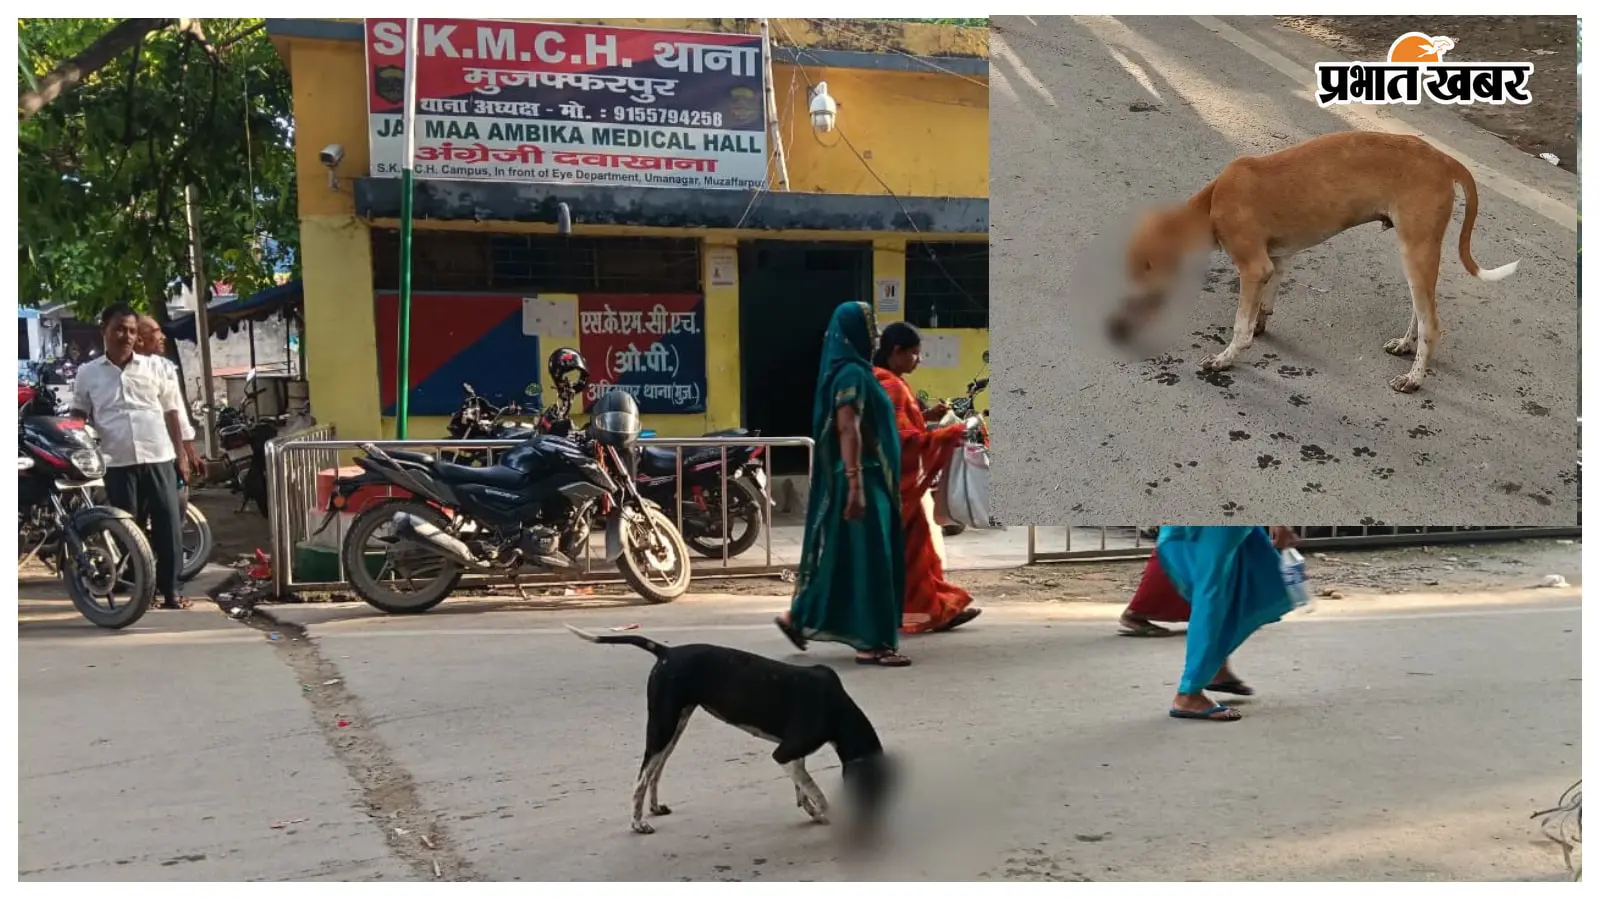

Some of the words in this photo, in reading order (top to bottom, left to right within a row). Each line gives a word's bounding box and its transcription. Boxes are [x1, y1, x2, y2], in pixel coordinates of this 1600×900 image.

[373, 22, 632, 67] SK.M.C.H.
[653, 41, 759, 77] थाना
[462, 66, 679, 103] मुजफ्फरपुर
[420, 98, 468, 114] थाना
[474, 101, 541, 117] अध्यक्ष
[614, 106, 722, 128] 9155794258
[377, 119, 415, 138] JA
[425, 120, 480, 140] MAA
[488, 123, 585, 145] AMBIKA
[592, 127, 696, 150] MEDICAL
[704, 134, 762, 154] HALL
[377, 163, 438, 175] S.K.C.H.
[441, 164, 492, 177] Campus,
[495, 166, 505, 176] In
[508, 166, 535, 178] front
[538, 168, 549, 178] of
[552, 169, 573, 180] Eye
[575, 169, 642, 183] Department,
[415, 141, 545, 165] अंग्रेजी
[552, 151, 719, 173] दवाखाना
[606, 342, 680, 380] (ओ.पी.)
